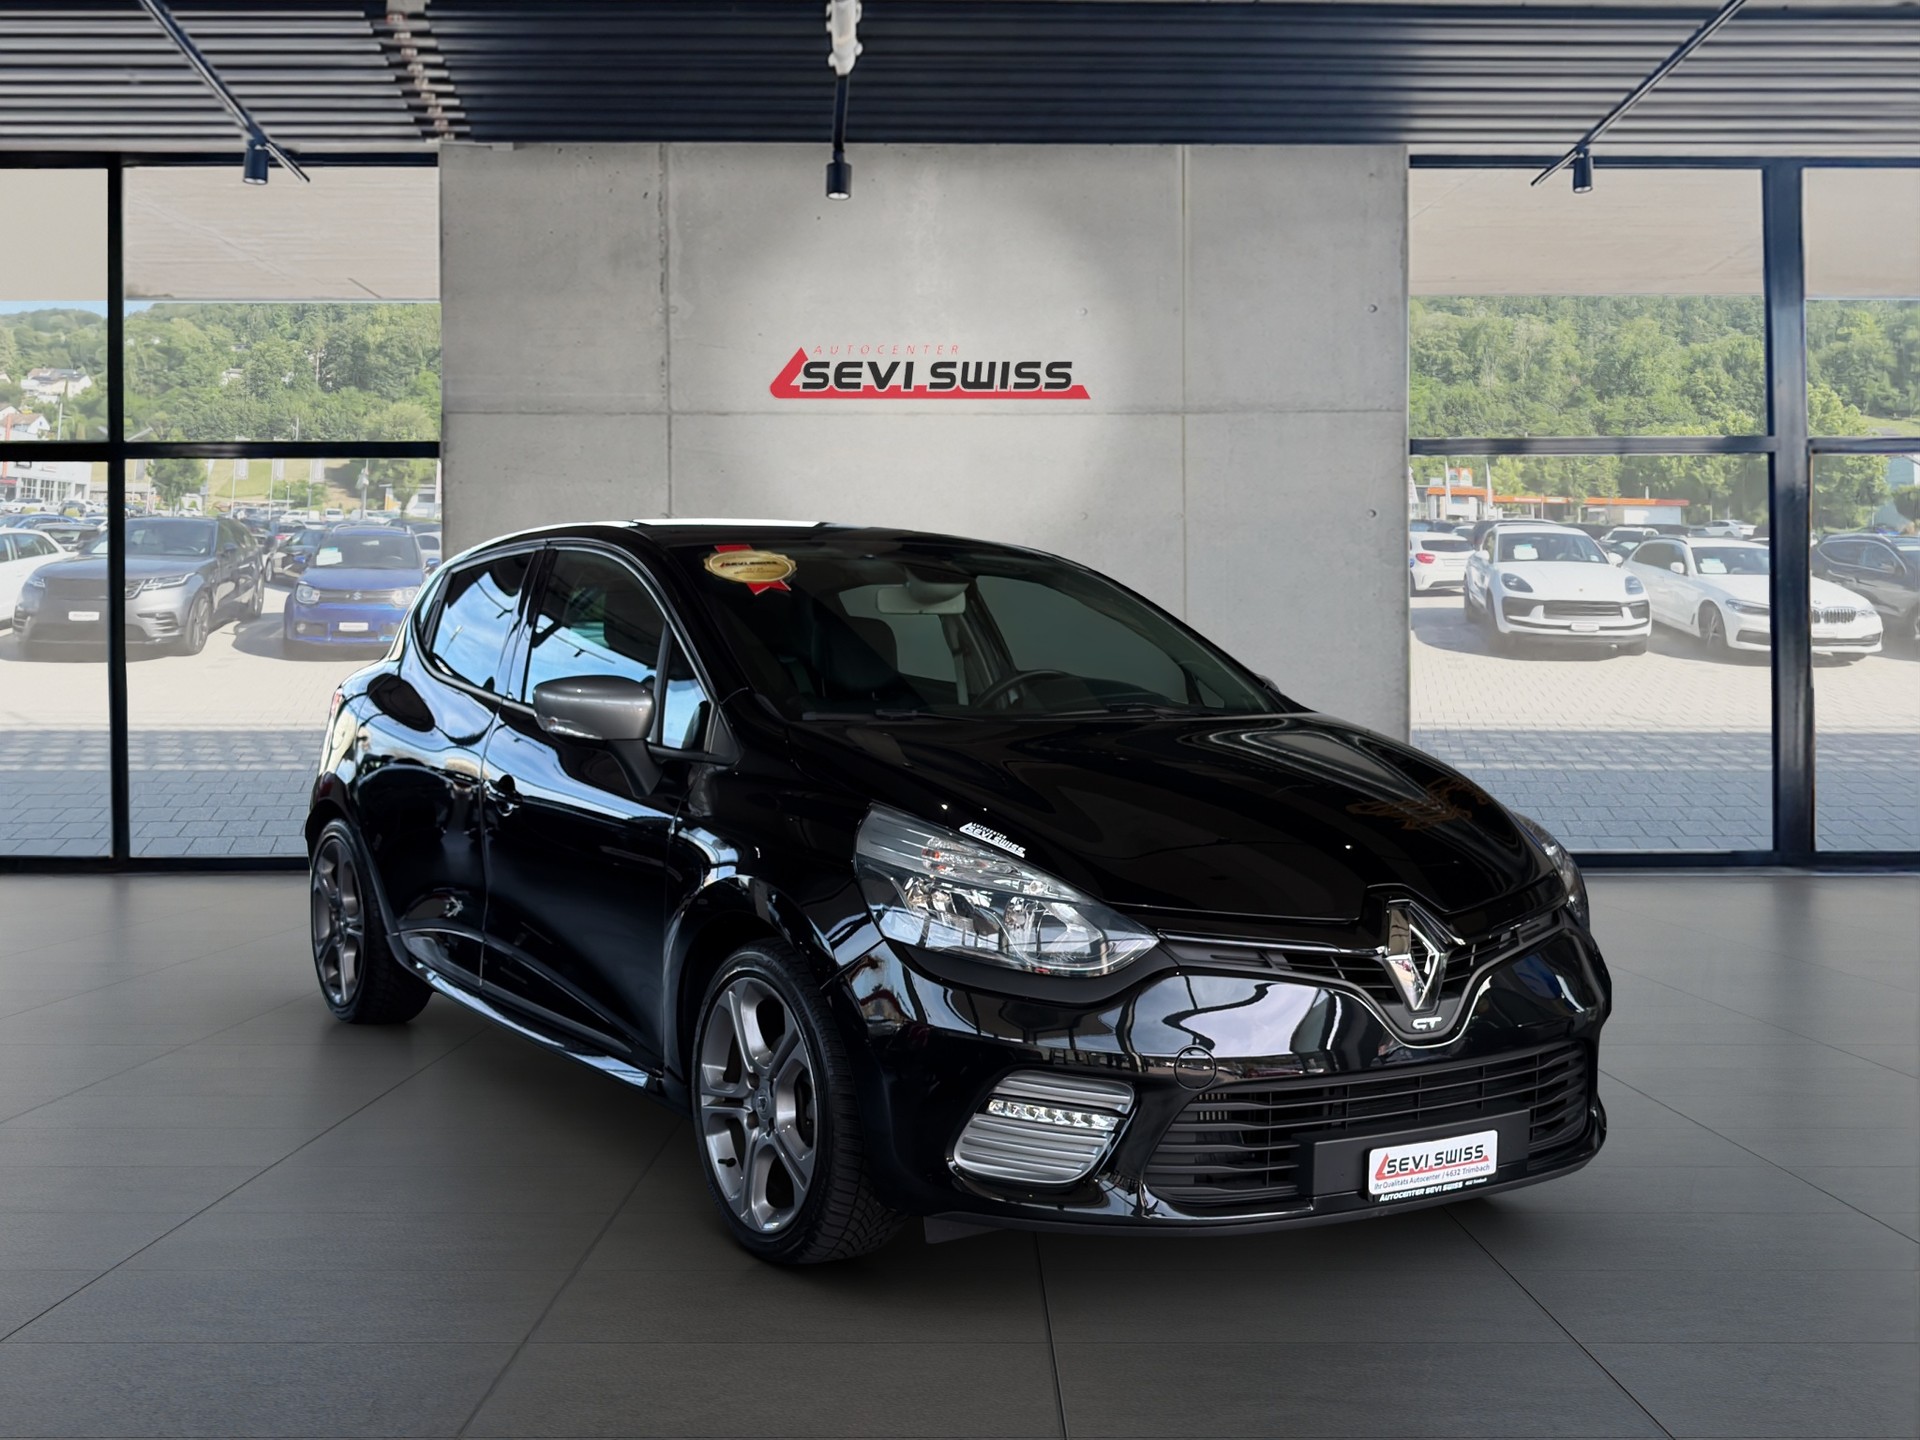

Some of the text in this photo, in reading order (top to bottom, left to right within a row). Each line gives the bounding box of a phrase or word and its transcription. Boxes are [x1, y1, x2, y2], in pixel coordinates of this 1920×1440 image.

[813, 345, 960, 355] AUTOCENTER
[801, 361, 1073, 390] SEVI SWISS
[966, 825, 1026, 854] SEVI SWISS
[1412, 1016, 1442, 1030] GT
[1386, 1144, 1484, 1174] SEVI SWISS
[1374, 1182, 1382, 1190] Ihr
[1410, 1173, 1441, 1184] Autocenter
[1462, 1163, 1490, 1175] Trimbach
[1425, 1185, 1442, 1194] SEVI
